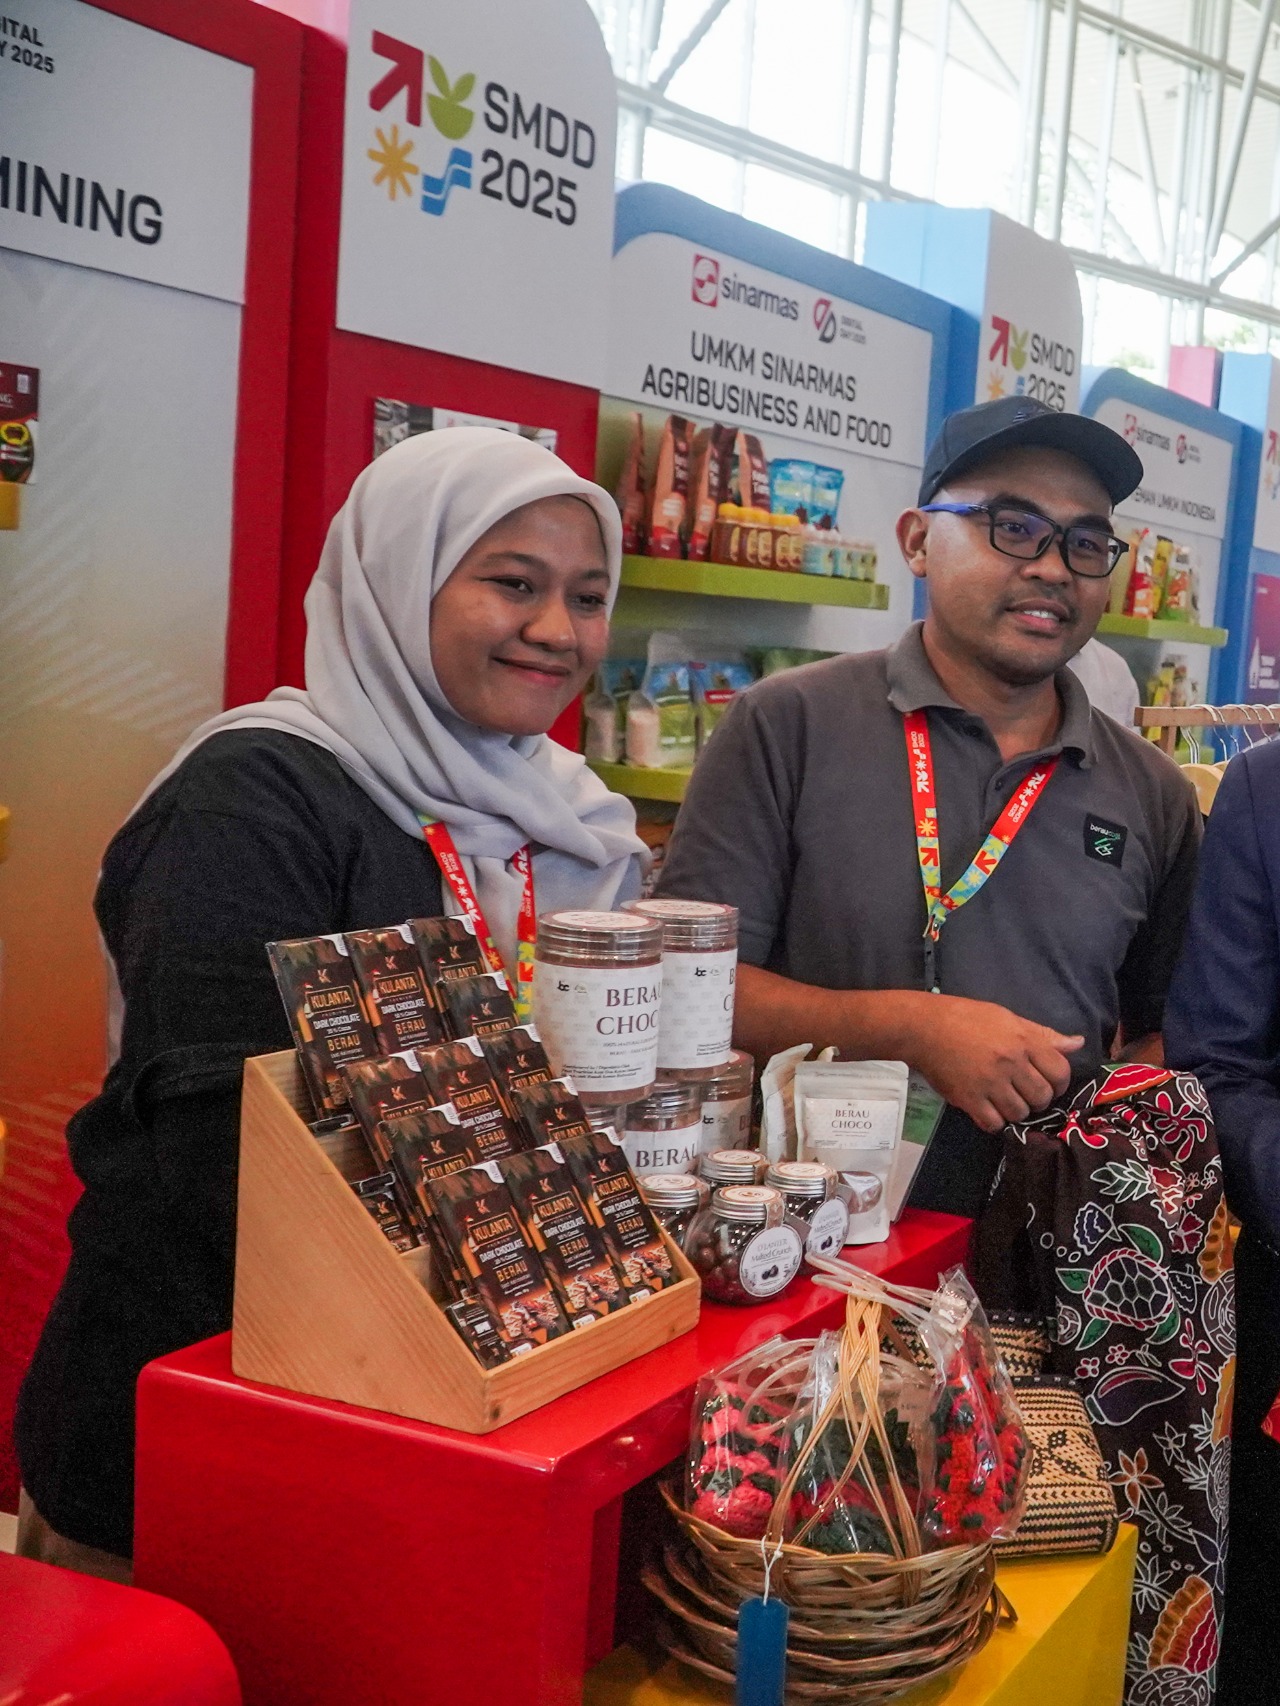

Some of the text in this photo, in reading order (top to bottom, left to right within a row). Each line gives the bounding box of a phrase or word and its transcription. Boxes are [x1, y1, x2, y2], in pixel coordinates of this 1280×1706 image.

[0, 16, 43, 47] ITAL
[11, 45, 55, 74] 2025
[483, 82, 596, 169] SMDD
[480, 150, 578, 226] 2025
[0, 155, 162, 245] INING
[721, 274, 799, 321] sinarmas
[1031, 333, 1075, 377] SMDD
[691, 330, 857, 402] UMKM SINARMAS
[1028, 373, 1066, 412] 2025
[641, 364, 892, 448] AGRIBUSINESS AND FOOD
[379, 977, 417, 994] KULANTA
[311, 991, 351, 1008] KULANTA
[396, 998, 426, 1012] CHOCOLATE
[329, 1013, 360, 1027] CHOCOLATE
[395, 1018, 426, 1035] BERAU
[327, 1034, 360, 1051] BERAU
[456, 1089, 492, 1108] KULANTA
[475, 1109, 503, 1123] CHOCOLATE
[836, 1109, 869, 1118] BERAU
[832, 1120, 872, 1129] CHOCO
[475, 1129, 506, 1148] BERAU
[596, 1177, 630, 1196] KULANTA
[538, 1196, 574, 1218] KULANTA
[614, 1196, 640, 1211] CHOCOLATE
[473, 1217, 513, 1241] KULANTA
[557, 1216, 586, 1233] CHOCOLATE
[617, 1215, 644, 1234] BERAU
[495, 1238, 525, 1256] CHOCOLATE
[559, 1237, 589, 1257] BERAU
[496, 1260, 528, 1282] BERAU
